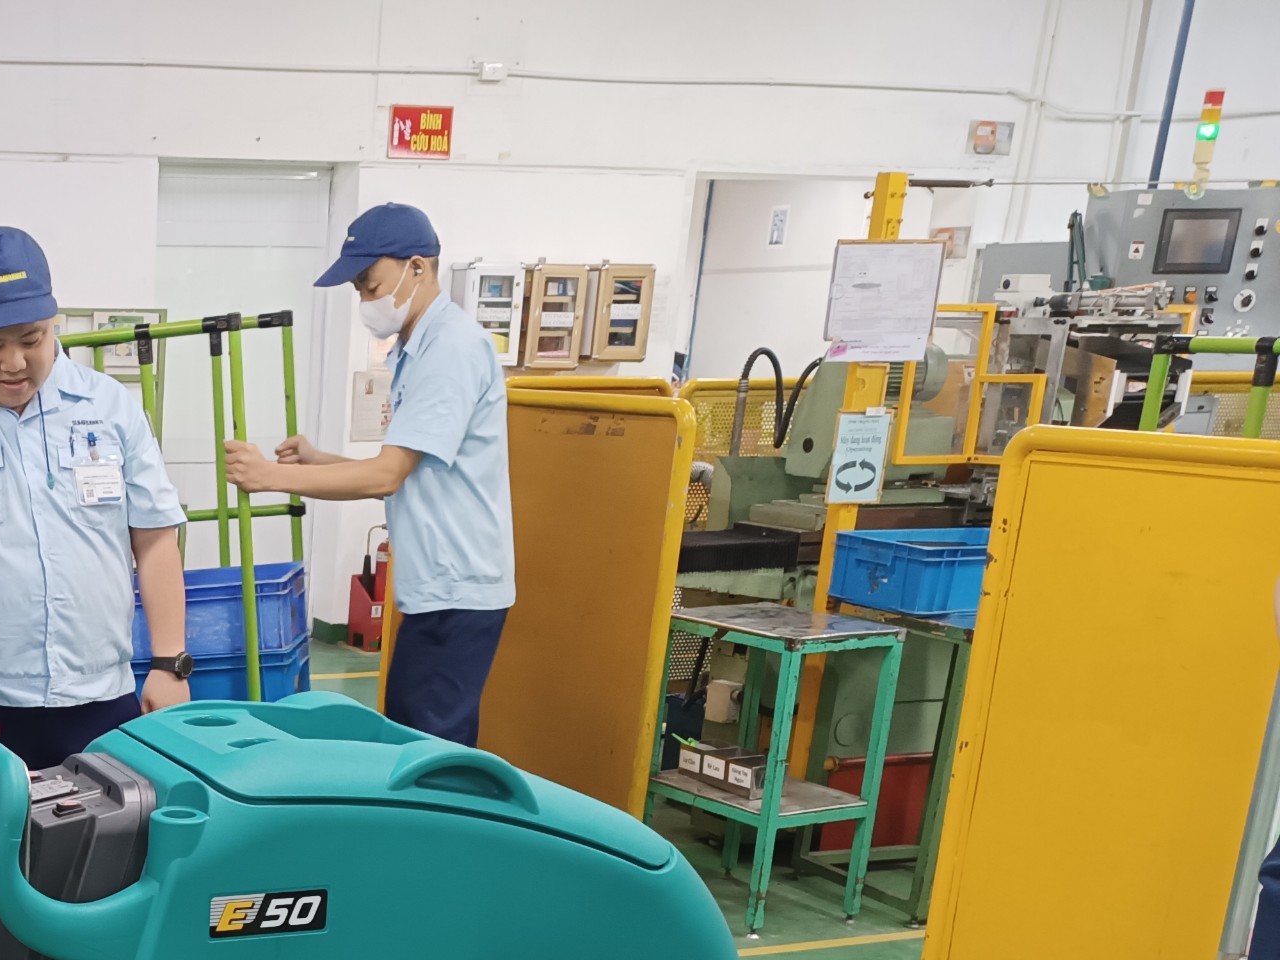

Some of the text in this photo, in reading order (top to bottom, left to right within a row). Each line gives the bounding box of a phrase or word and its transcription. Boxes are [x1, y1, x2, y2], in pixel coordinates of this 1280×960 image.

[411, 131, 429, 151] CỨU
[216, 895, 322, 932] E 50
